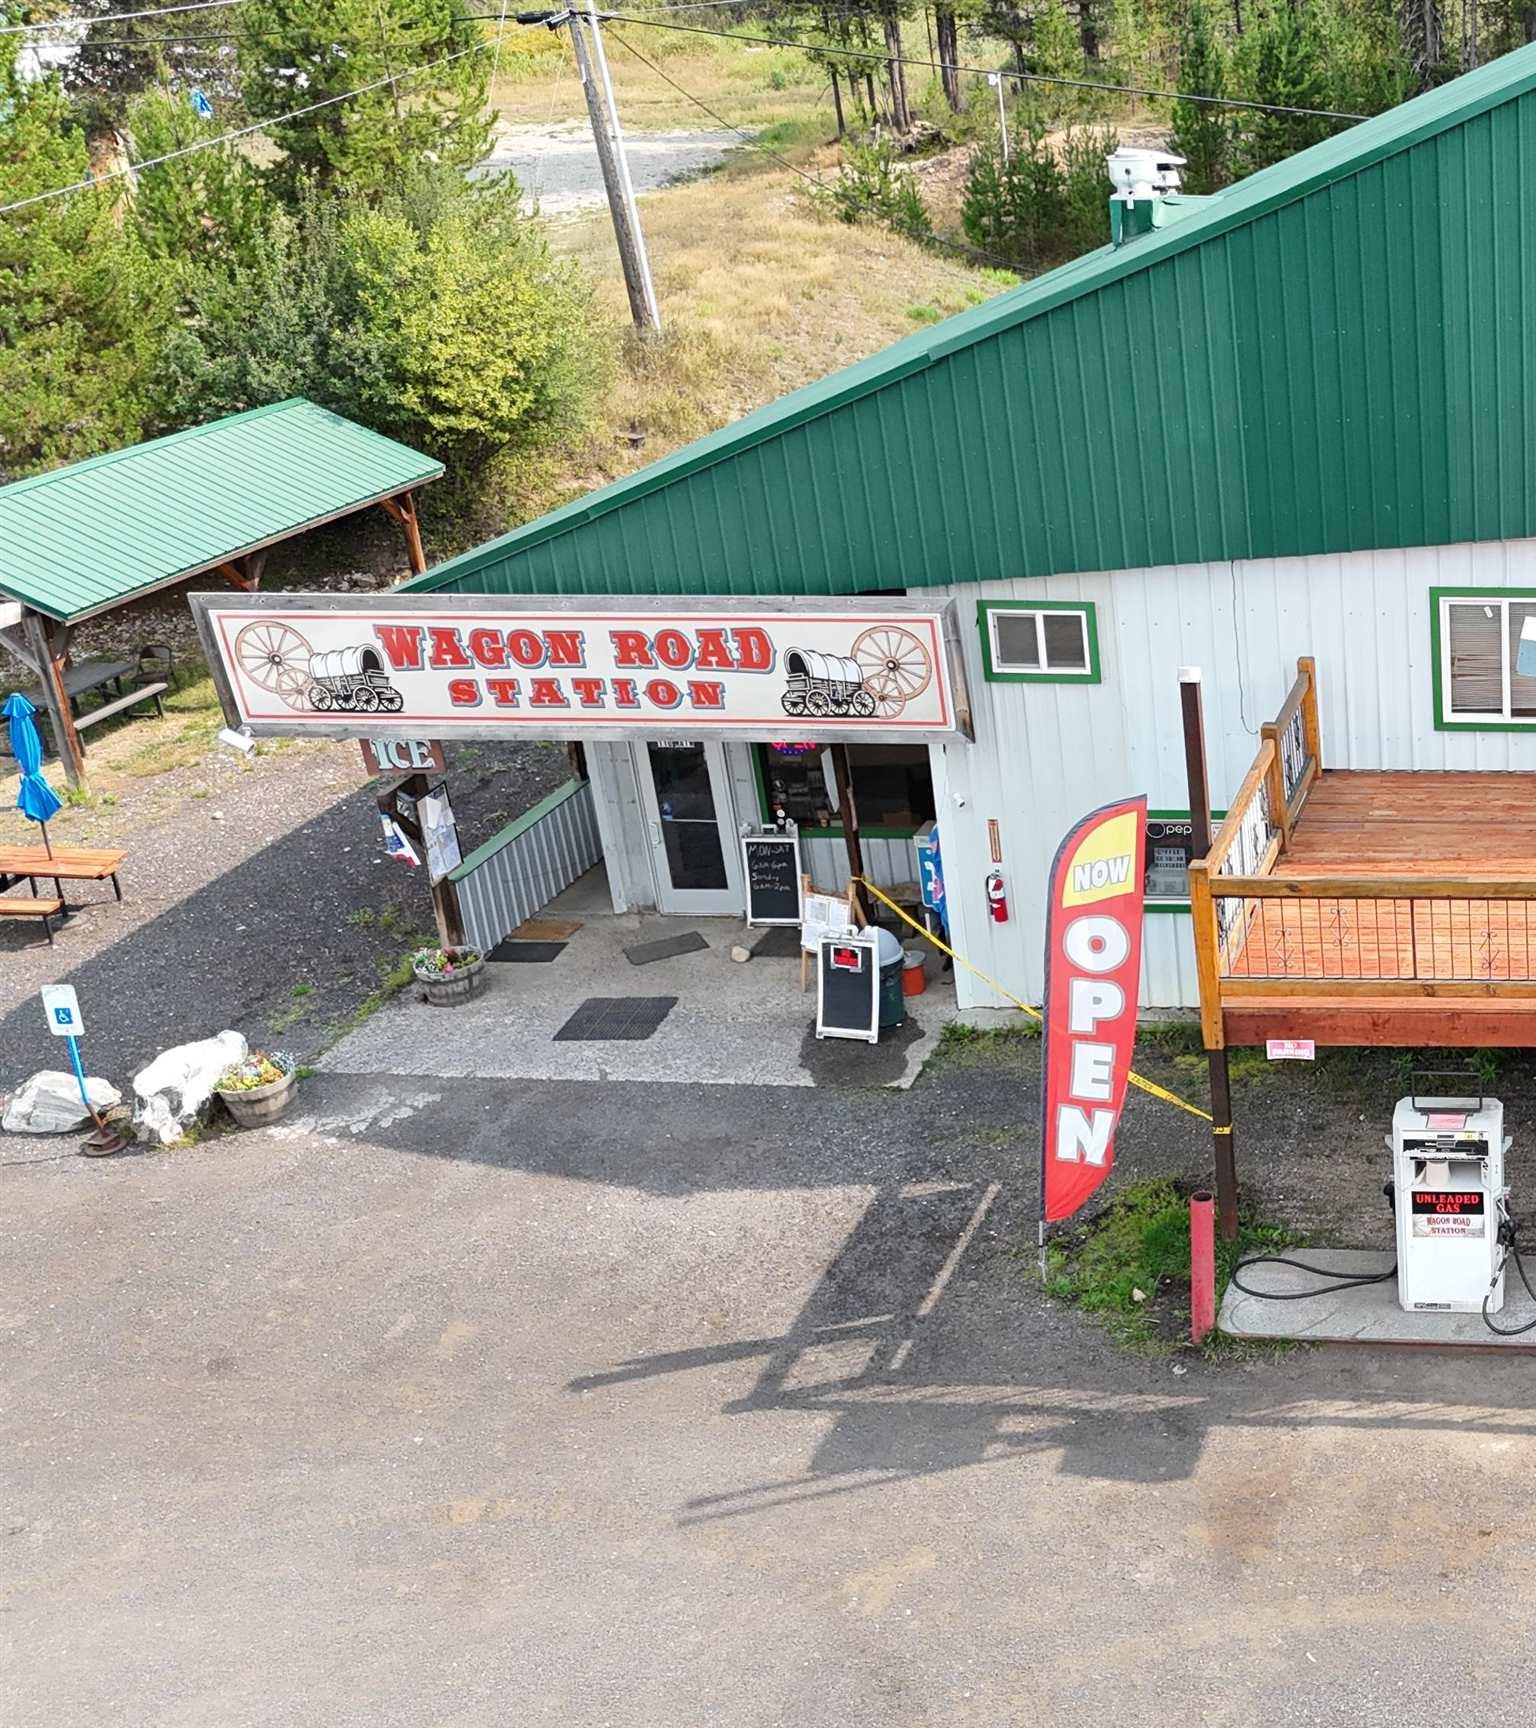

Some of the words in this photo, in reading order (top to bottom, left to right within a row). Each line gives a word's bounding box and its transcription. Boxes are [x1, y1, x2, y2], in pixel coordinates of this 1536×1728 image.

[373, 624, 586, 671] WAGON
[609, 626, 777, 674] ROAD
[448, 678, 726, 709] STATION
[371, 738, 436, 769] ICE
[1073, 855, 1131, 892] NOW
[1056, 915, 1131, 1168] OPEN
[1416, 1194, 1479, 1204] UNLEADED
[1436, 1203, 1461, 1213] GAS
[1426, 1216, 1450, 1226] WAGON
[1452, 1217, 1471, 1226] ROAD
[1431, 1227, 1466, 1235] STATION
